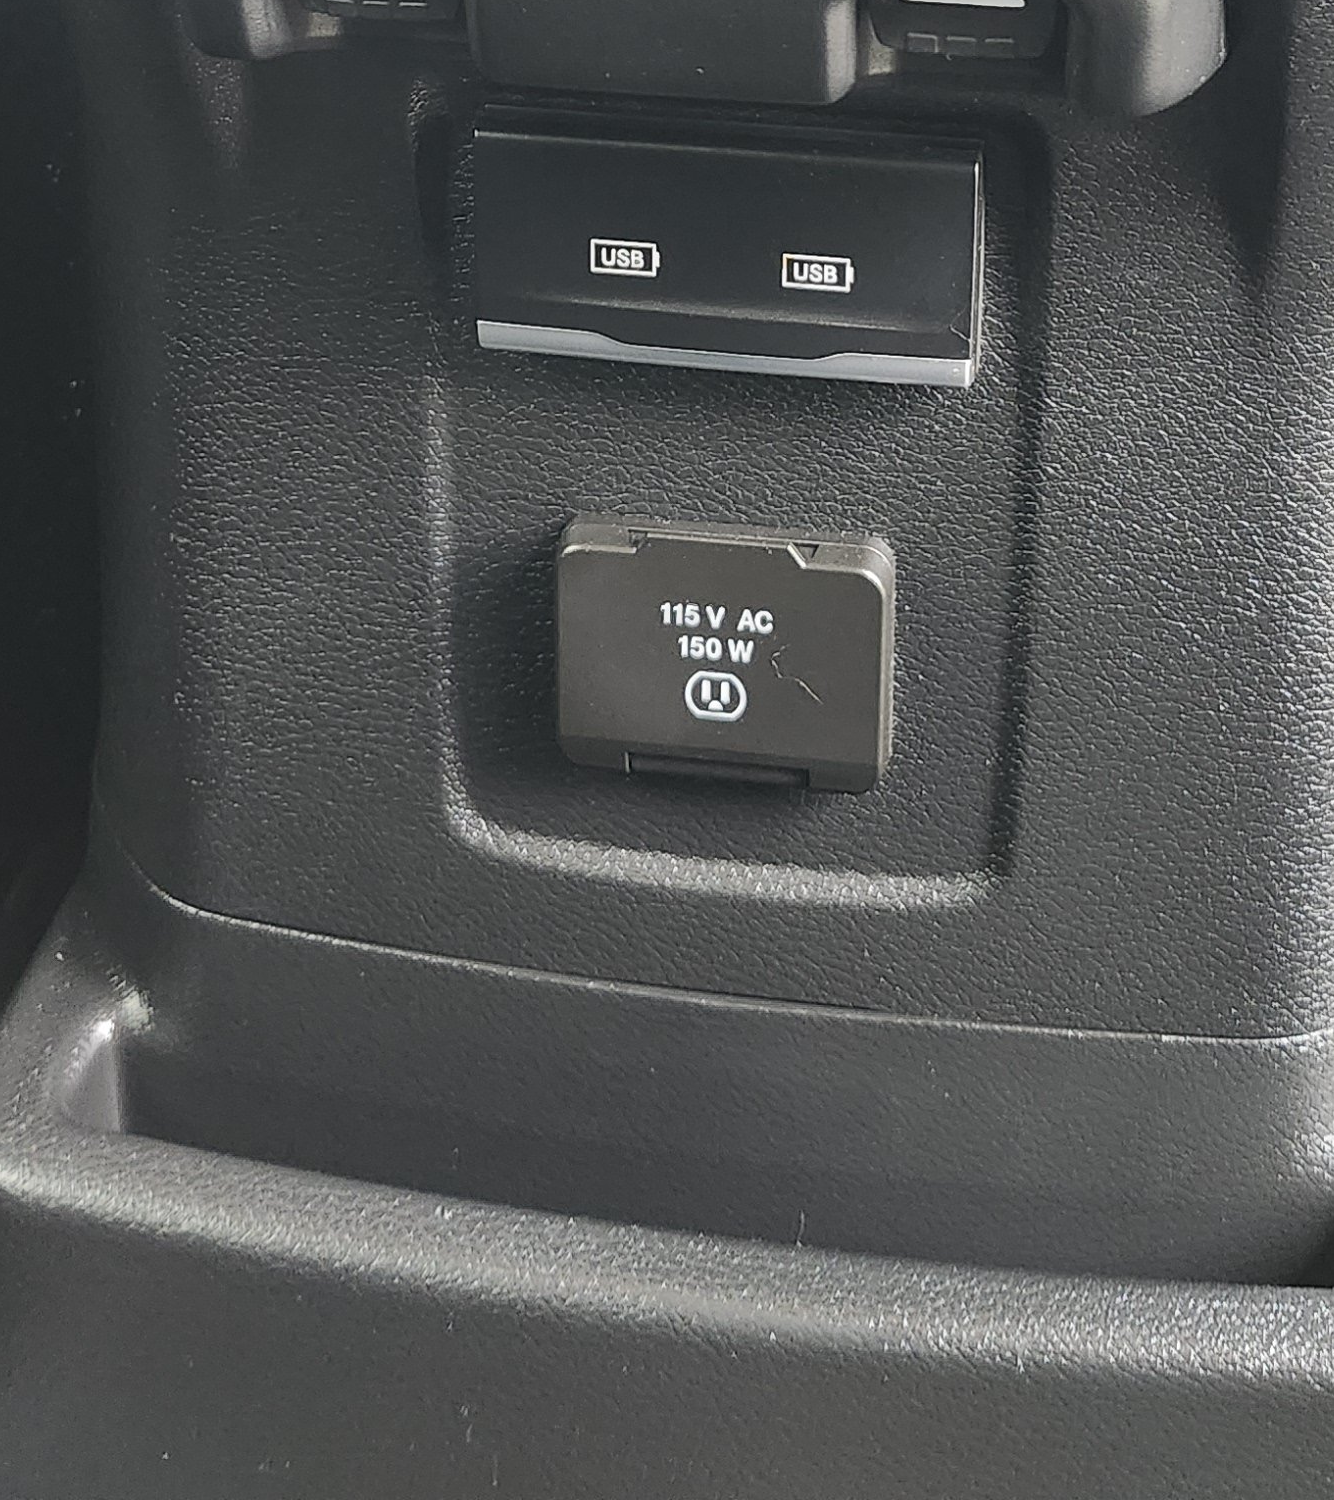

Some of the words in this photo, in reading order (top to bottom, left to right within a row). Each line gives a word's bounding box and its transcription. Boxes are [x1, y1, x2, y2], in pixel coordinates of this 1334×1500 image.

[600, 247, 645, 269] USB
[792, 262, 839, 284] USB
[660, 602, 701, 628] 115
[705, 605, 726, 630] V
[736, 608, 774, 634] AC
[678, 634, 723, 661] 150
[727, 637, 755, 664] W
